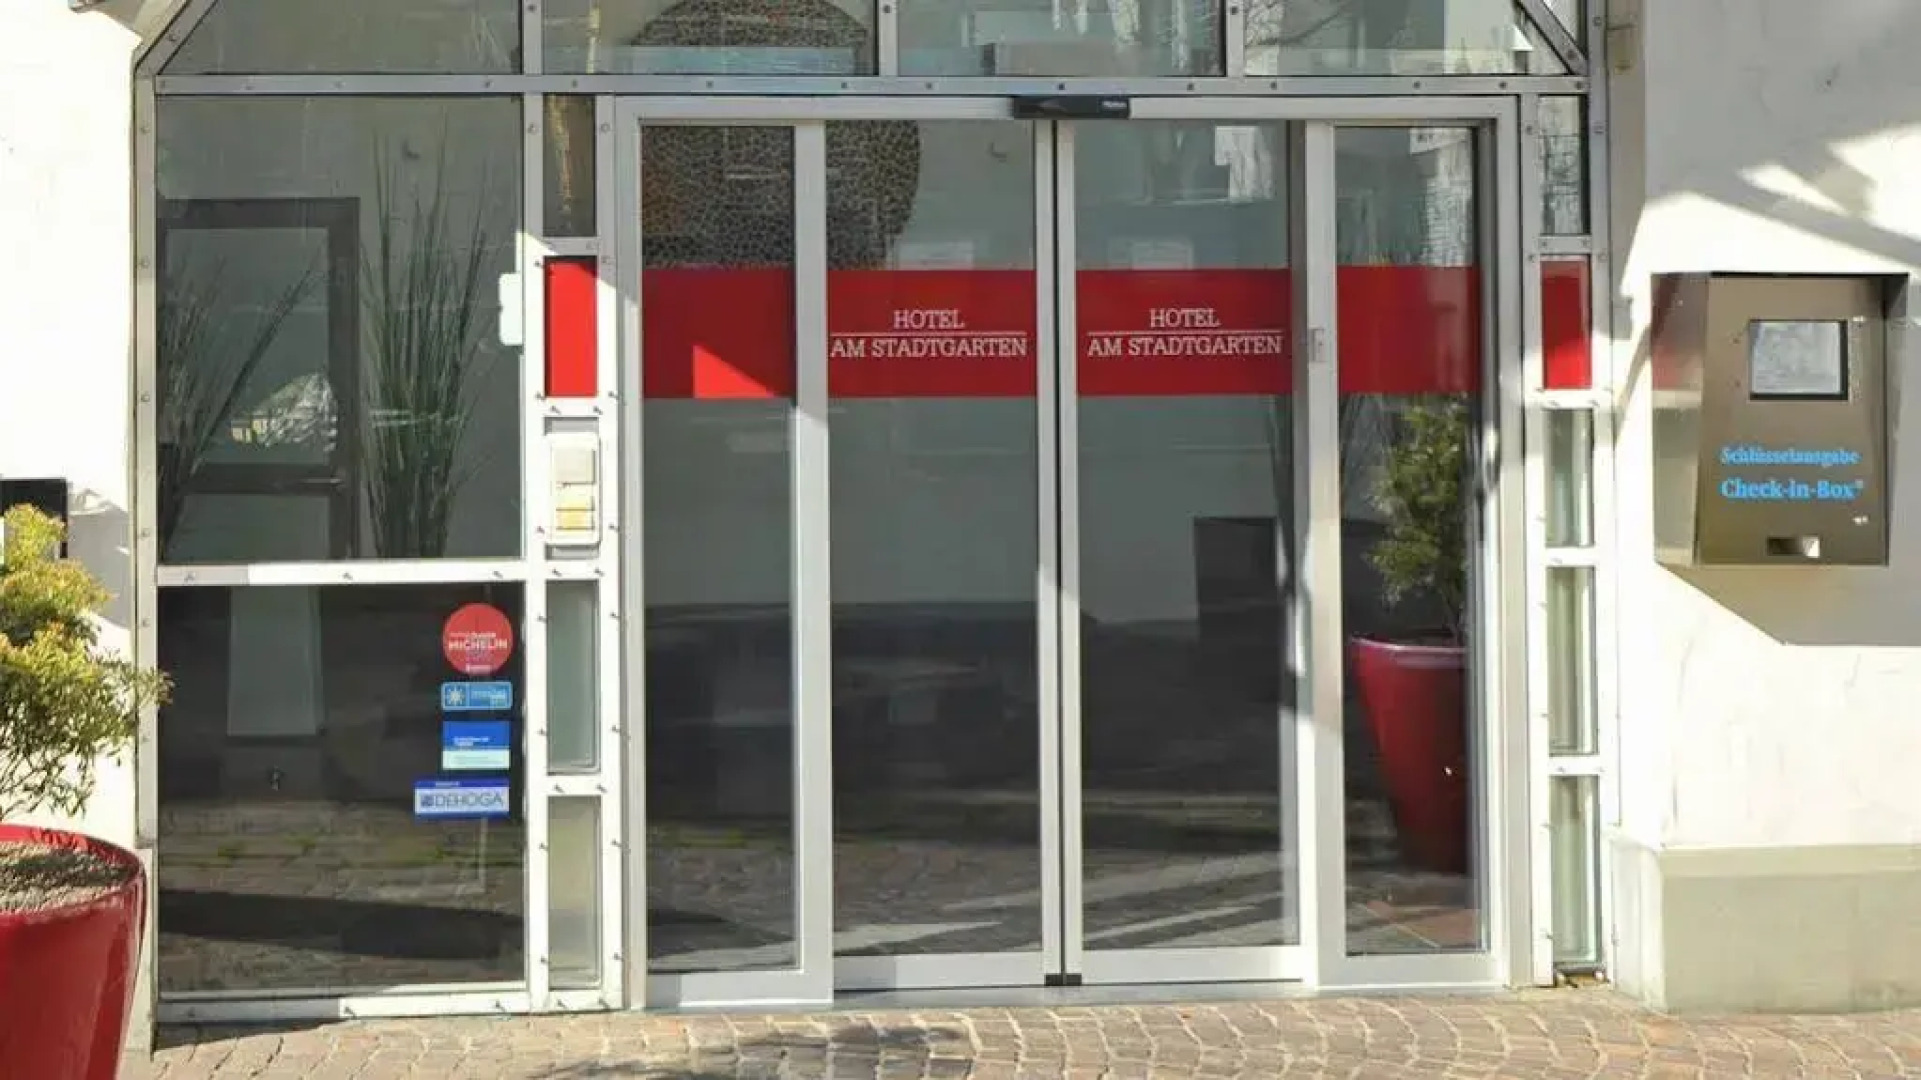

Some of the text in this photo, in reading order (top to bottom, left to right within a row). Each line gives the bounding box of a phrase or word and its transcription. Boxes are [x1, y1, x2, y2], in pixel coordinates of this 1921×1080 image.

[893, 308, 966, 330] HOTEL
[1149, 307, 1222, 328] HOTEL
[830, 336, 1028, 358] AM STADTGARTEN
[1087, 335, 1283, 357] AM STADTGARTEN
[448, 637, 508, 651] MICHELIN
[434, 792, 504, 808] DEHOGA
